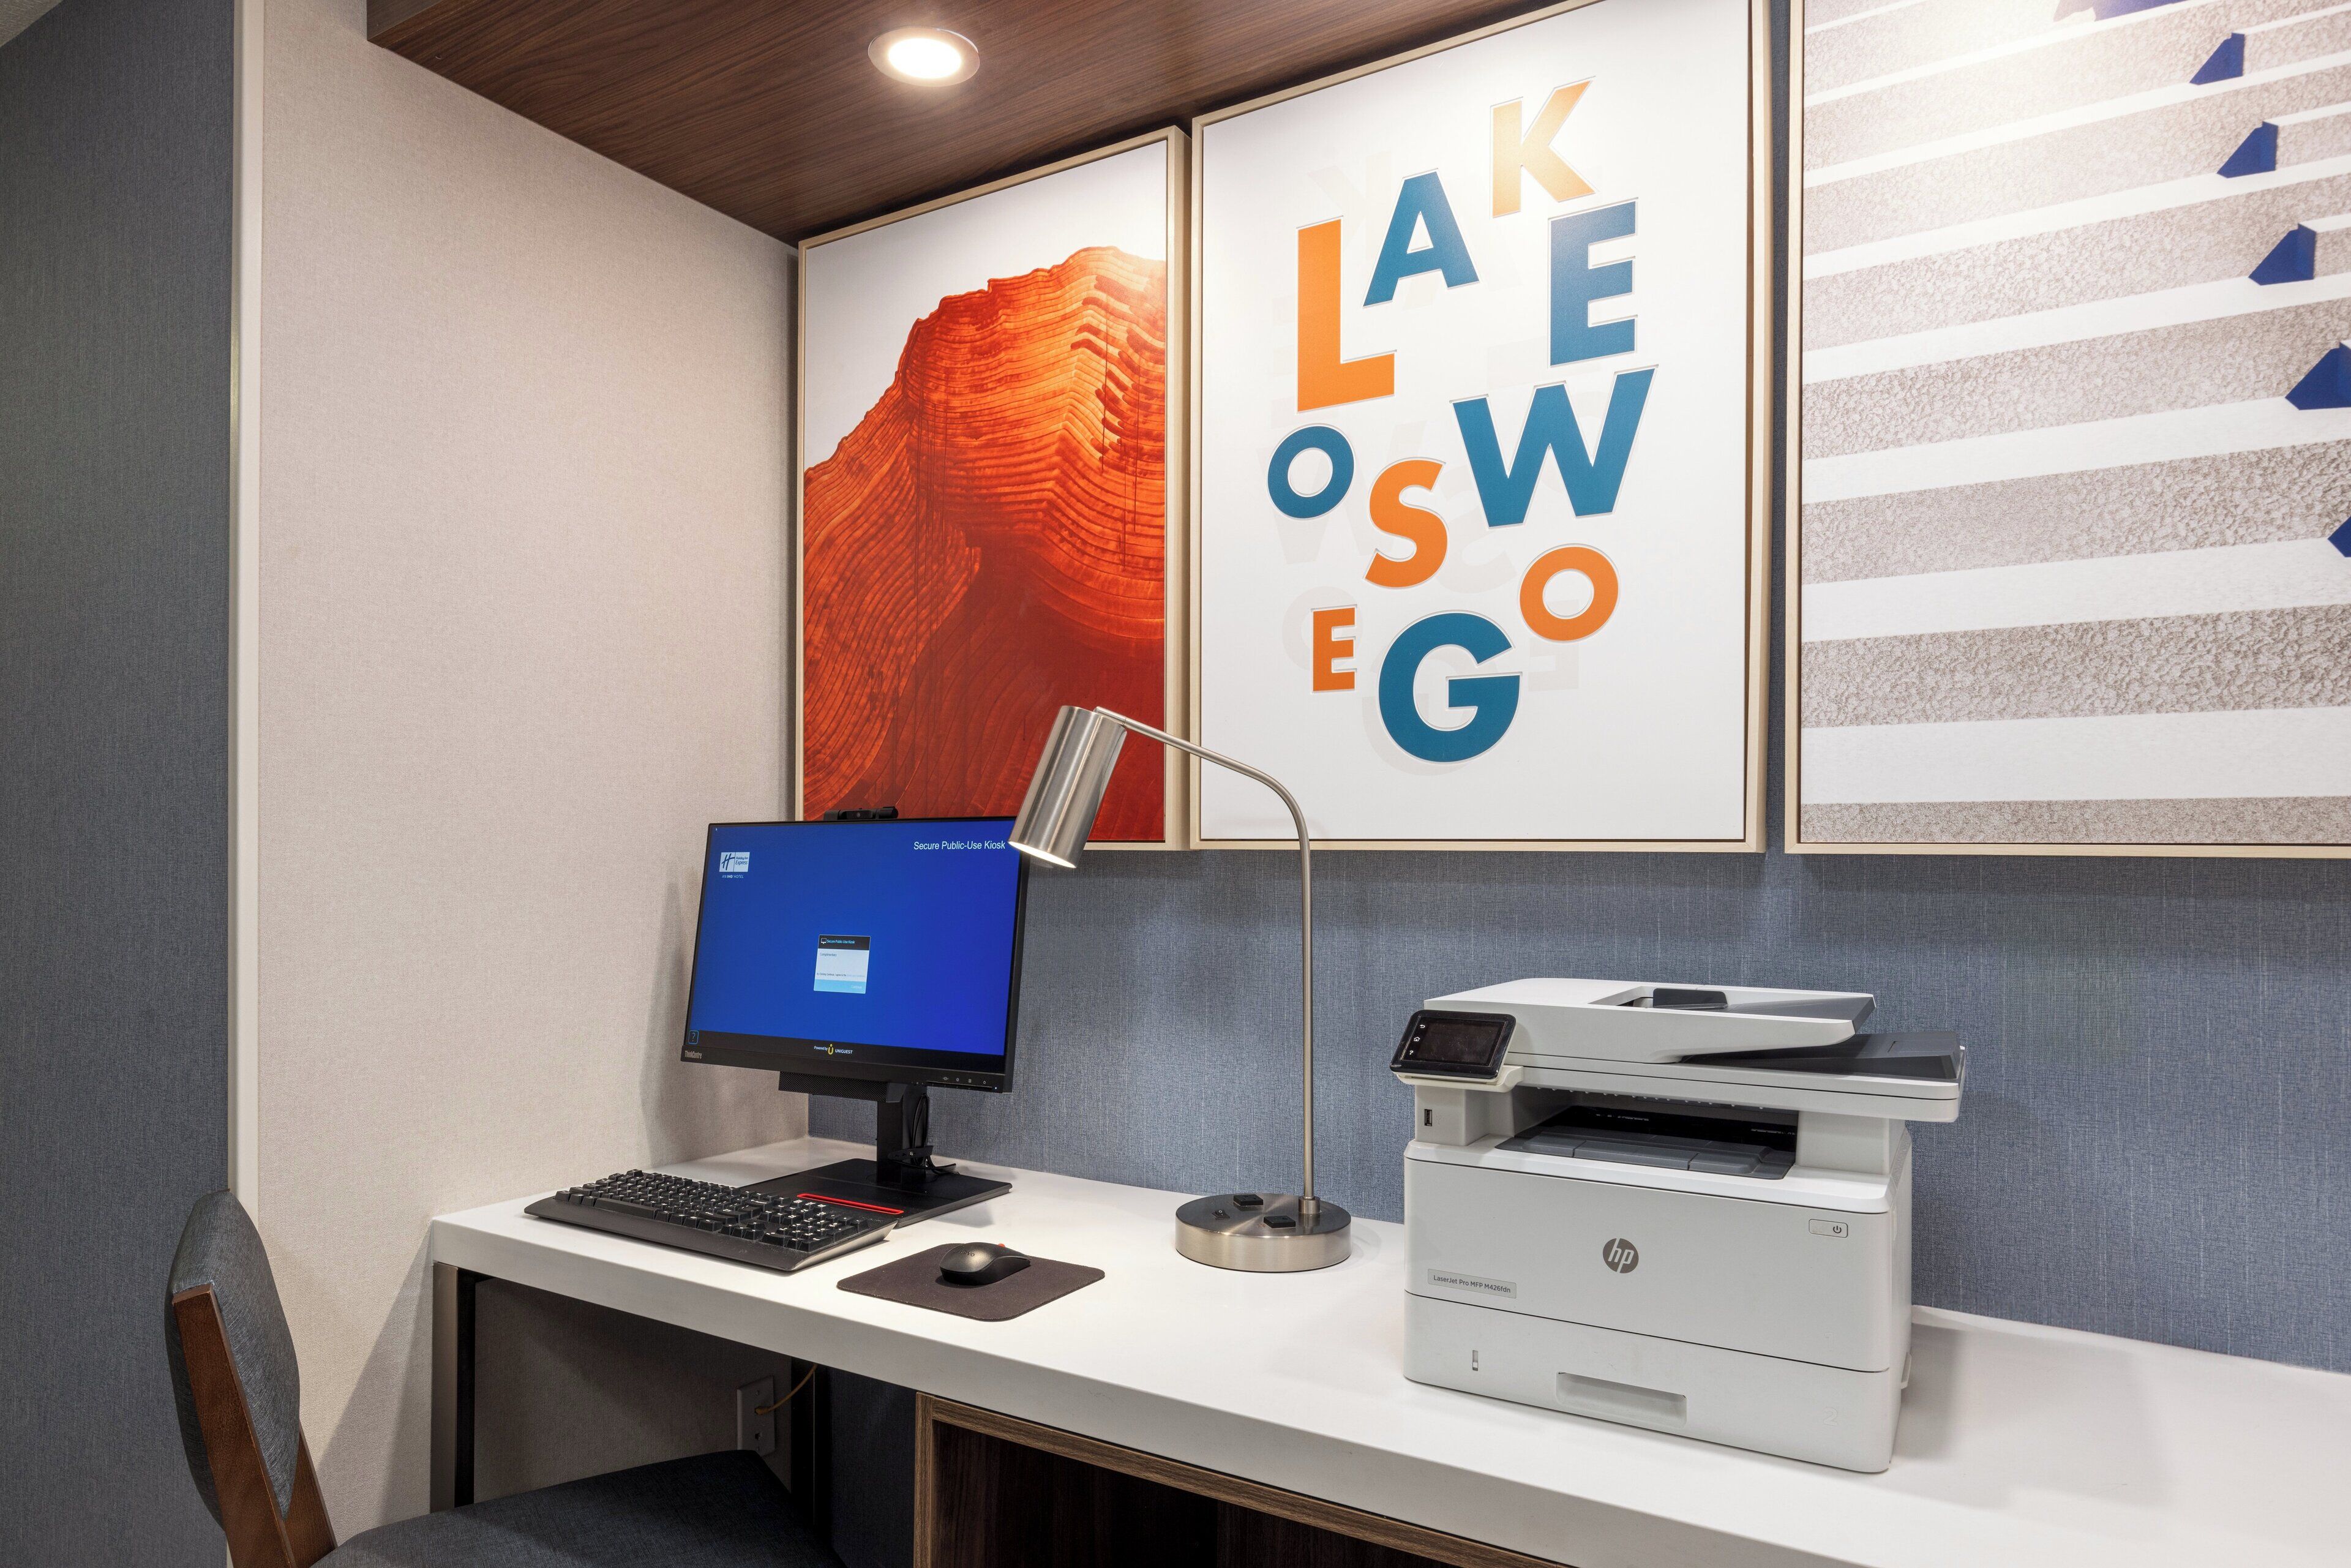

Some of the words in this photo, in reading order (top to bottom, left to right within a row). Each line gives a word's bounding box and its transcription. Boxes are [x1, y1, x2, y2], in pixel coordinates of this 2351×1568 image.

[913, 841, 939, 850] Secure
[942, 841, 982, 850] Public-Use
[984, 840, 1006, 849] Kiosk
[684, 1050, 702, 1059] ThinkCentre
[1433, 1275, 1457, 1284] LaserJet
[1484, 1283, 1511, 1293] M426fdn
[1823, 1406, 1838, 1425] 2
